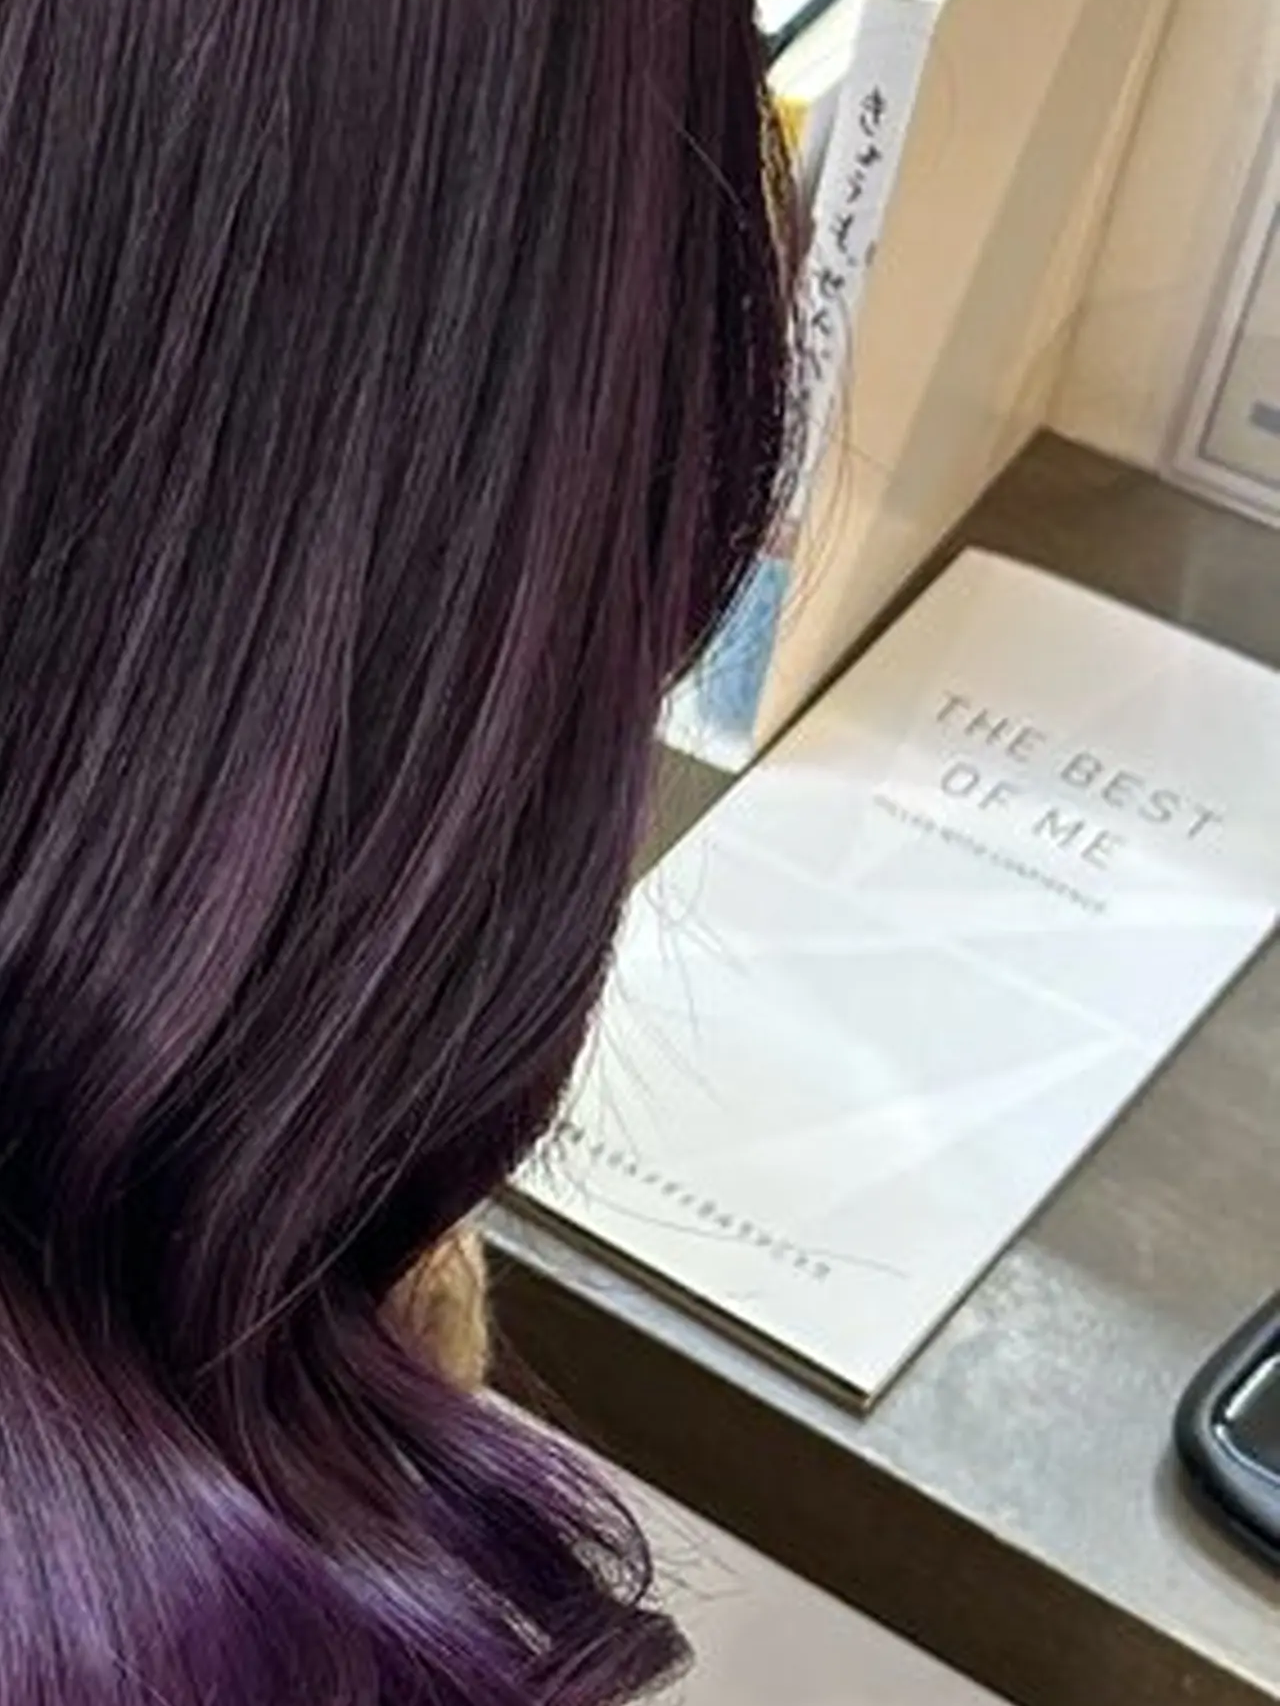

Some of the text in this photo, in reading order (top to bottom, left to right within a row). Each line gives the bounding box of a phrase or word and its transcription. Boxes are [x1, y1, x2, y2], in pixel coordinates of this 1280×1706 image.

[934, 690, 1223, 842] THE BEST
[940, 760, 1020, 812] OF
[1031, 807, 1126, 872] ME
